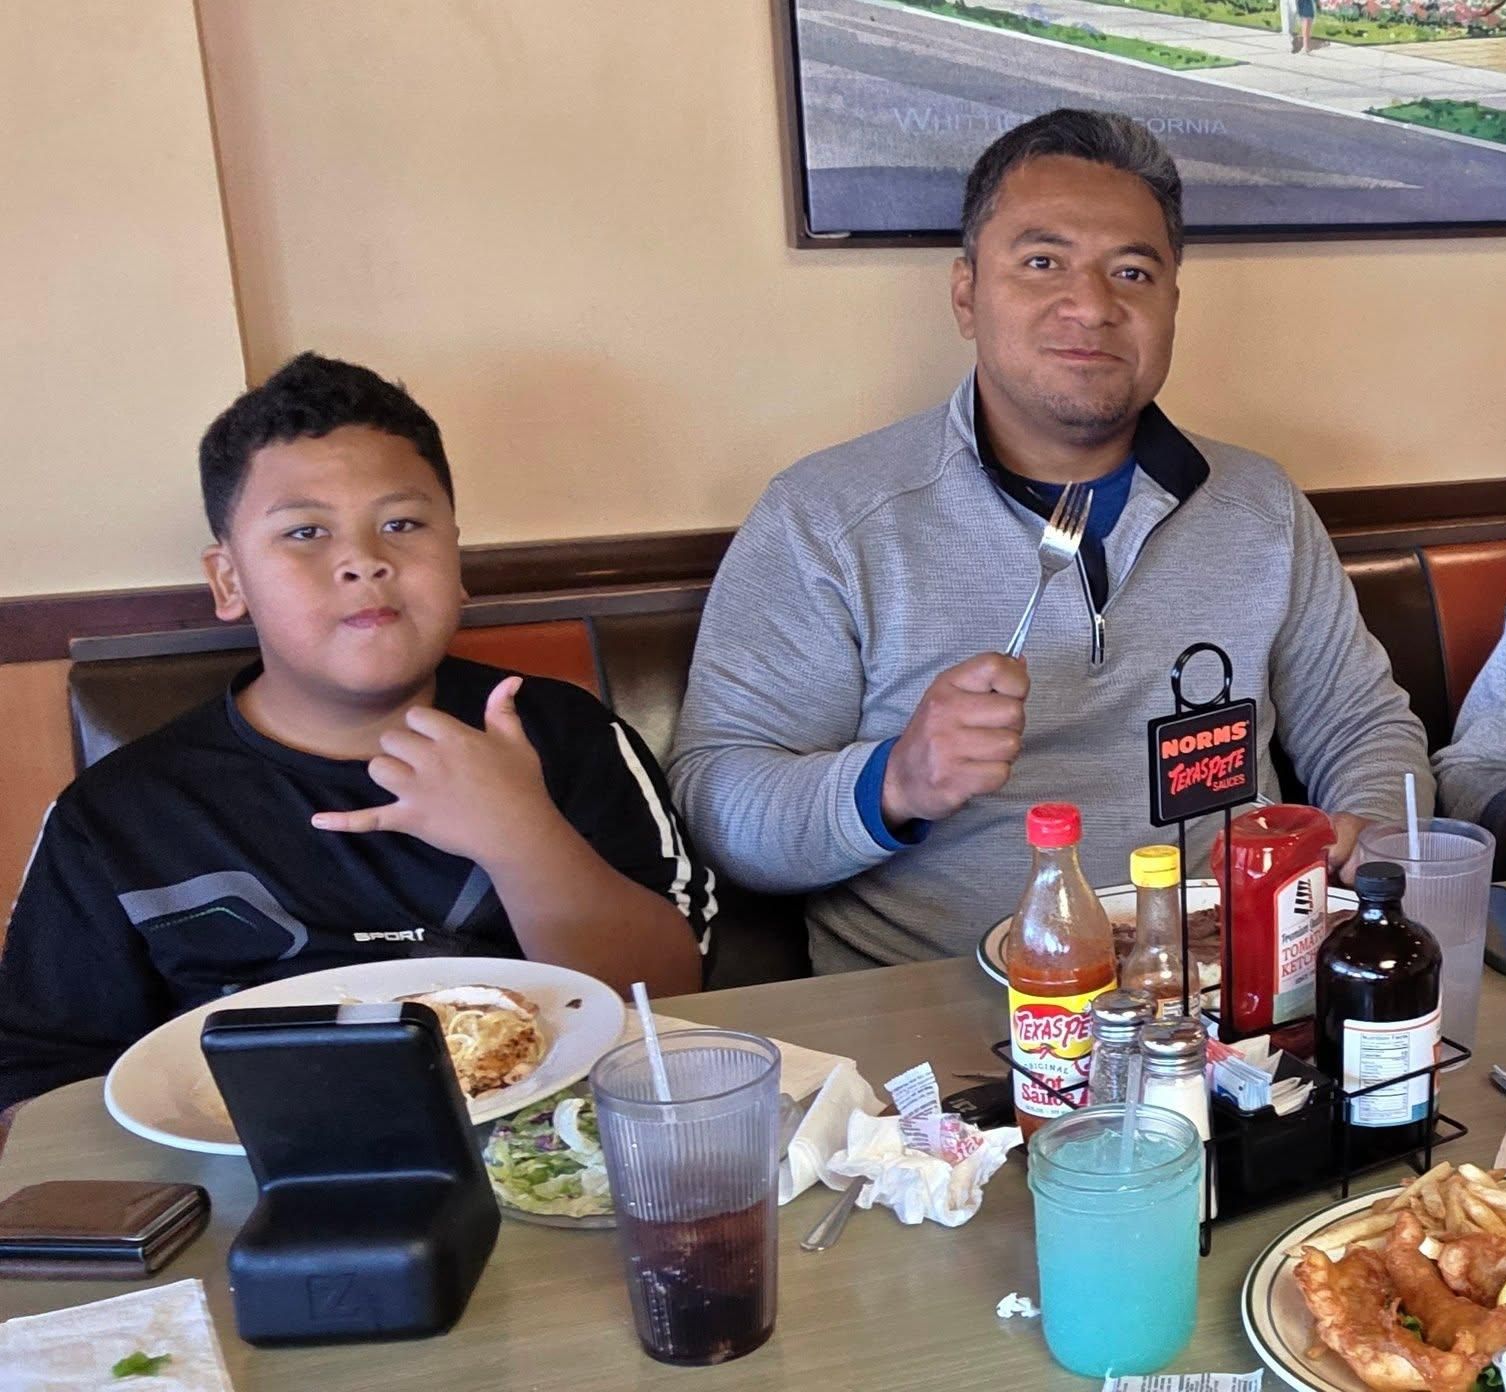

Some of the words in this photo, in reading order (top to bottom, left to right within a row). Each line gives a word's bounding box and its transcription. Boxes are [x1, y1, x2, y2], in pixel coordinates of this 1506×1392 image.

[1161, 720, 1248, 760] NORMS
[1212, 773, 1246, 792] SAUCES
[353, 927, 425, 942] SPORT
[1281, 947, 1316, 978] KETCH
[1062, 1012, 1093, 1048] PE
[1023, 1063, 1070, 1076] RIGINAL
